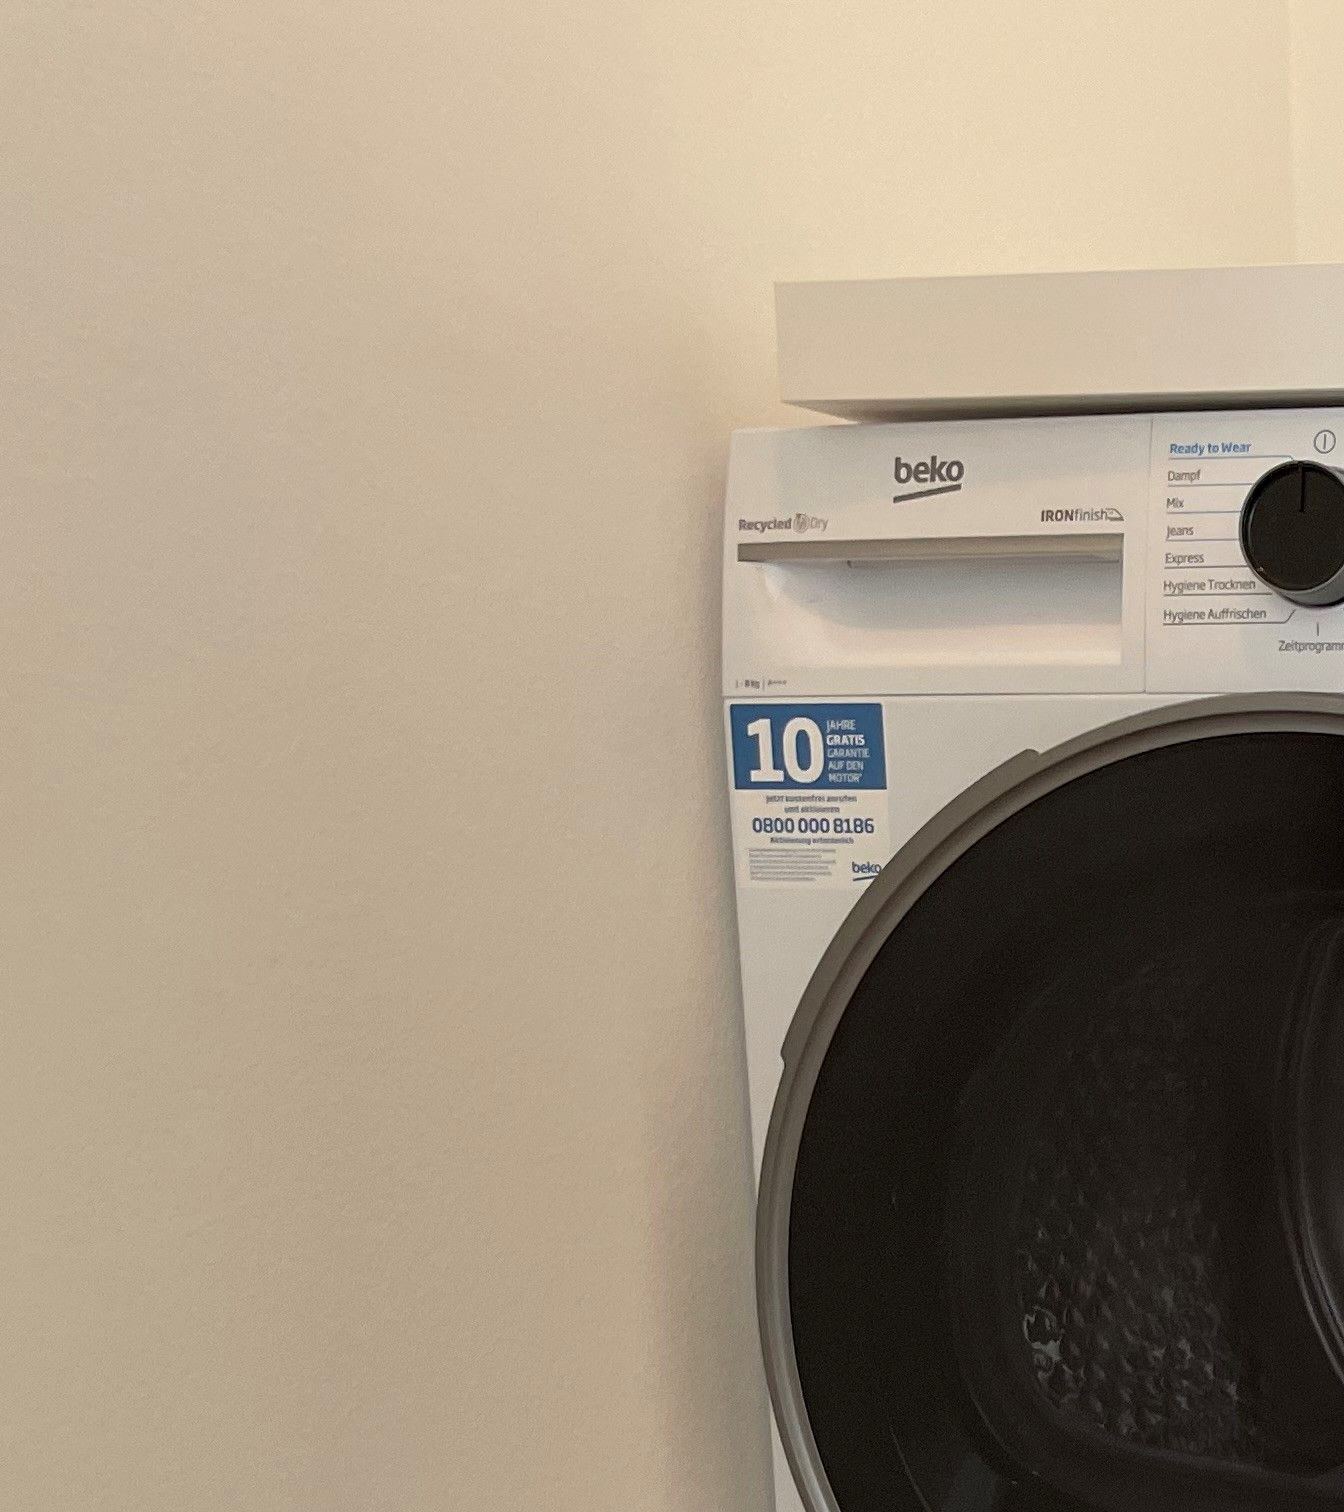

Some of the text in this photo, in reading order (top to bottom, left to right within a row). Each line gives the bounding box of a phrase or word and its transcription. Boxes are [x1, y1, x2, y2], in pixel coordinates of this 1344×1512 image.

[1169, 442, 1251, 456] Ready to Wear
[894, 456, 964, 484] beko
[1166, 497, 1185, 509] Mix
[1041, 508, 1108, 522] IRONfinish
[1166, 525, 1194, 538] Jeans
[1165, 552, 1205, 566] Express
[1163, 578, 1256, 595] Hygiene Trocknen
[1163, 607, 1267, 622] Hygiene Auffrischen
[826, 734, 866, 746] GRATIS
[746, 717, 825, 784] 10
[752, 817, 875, 834] 0800 000 8186
